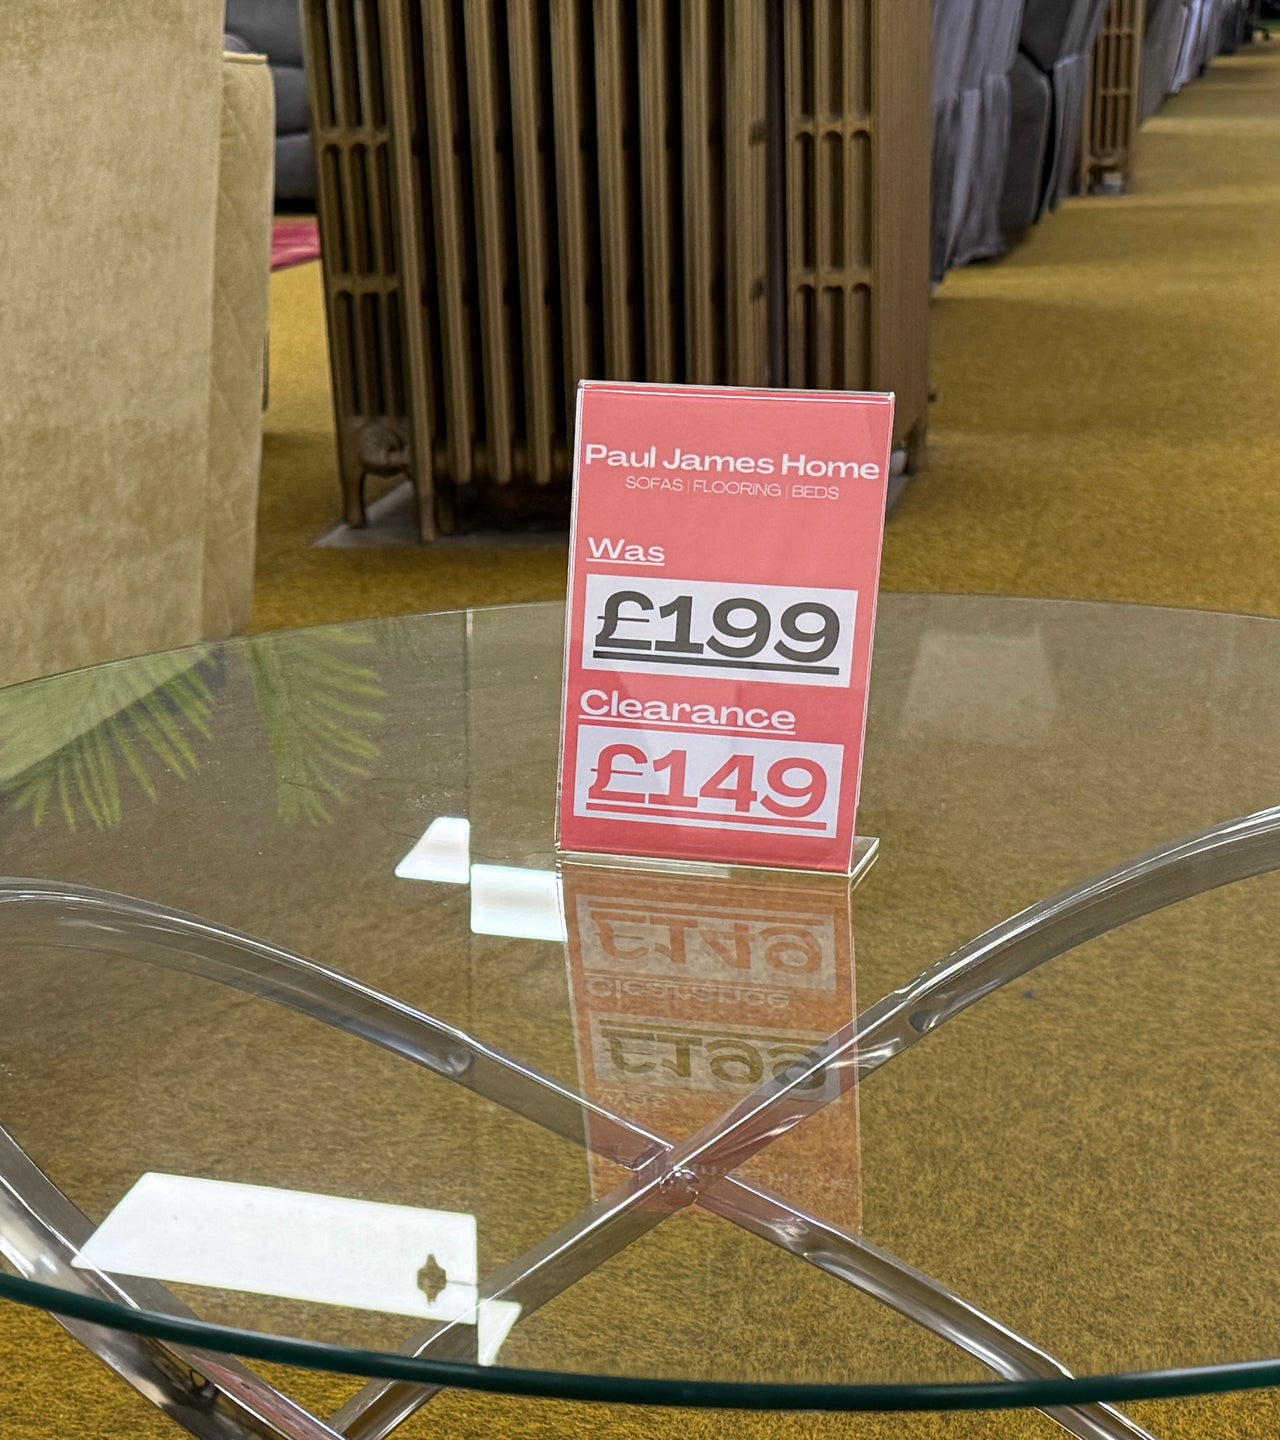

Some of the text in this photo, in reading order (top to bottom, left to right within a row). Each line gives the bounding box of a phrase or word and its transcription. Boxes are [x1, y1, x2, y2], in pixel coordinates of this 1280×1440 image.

[585, 444, 880, 480] Paul James Home
[625, 476, 840, 500] SOFAS FLOORING BEDS
[587, 537, 665, 563] Was
[594, 590, 841, 663] £199
[580, 690, 796, 730] Clearance
[587, 743, 828, 818] £149
